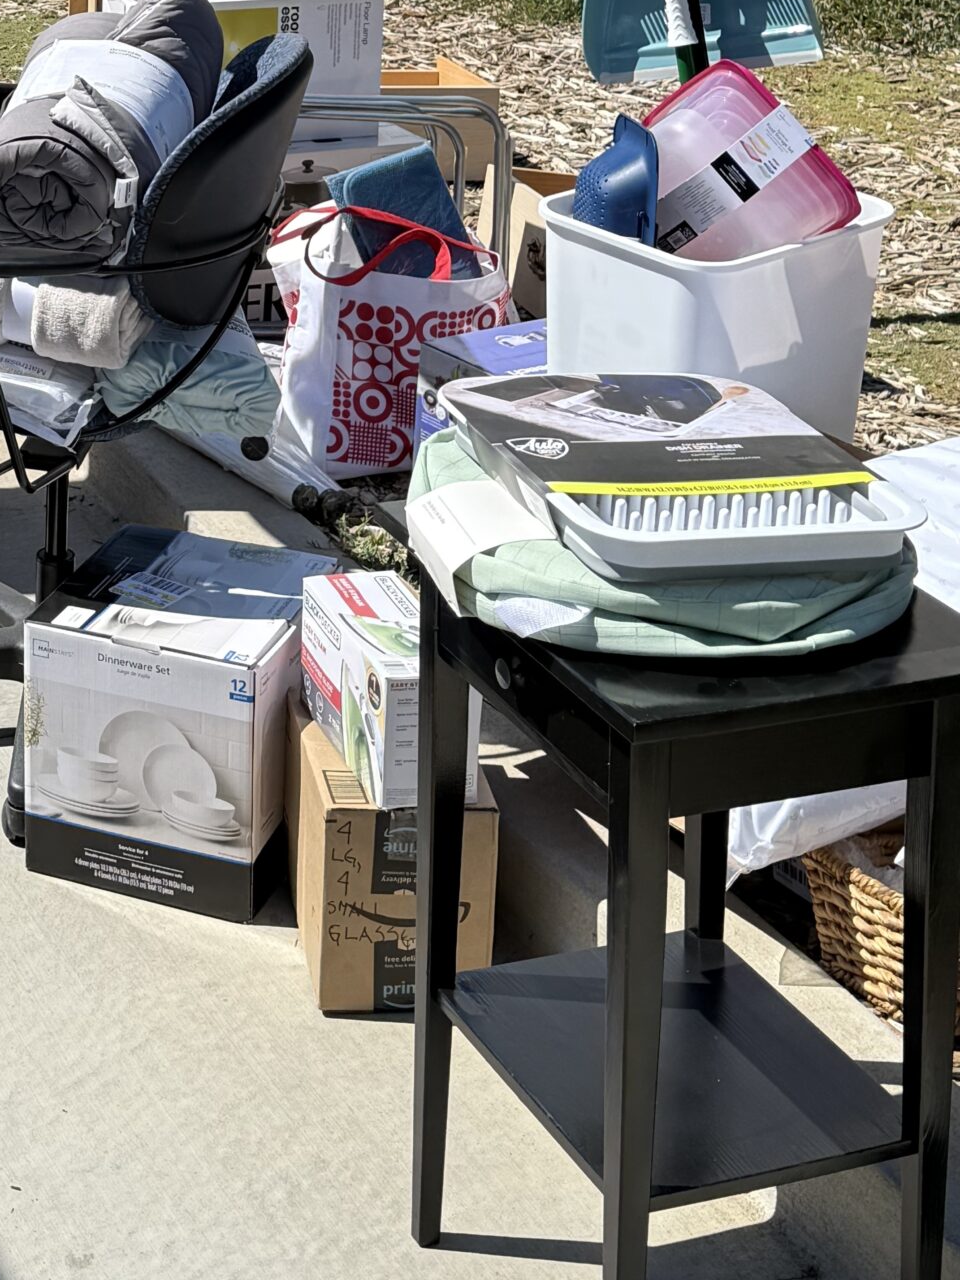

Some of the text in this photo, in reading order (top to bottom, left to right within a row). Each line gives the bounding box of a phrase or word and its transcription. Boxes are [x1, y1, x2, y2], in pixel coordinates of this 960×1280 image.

[280, 6, 290, 33] ess
[290, 6, 300, 33] roo
[361, 1, 371, 45] Floor Lamp
[305, 595, 340, 644] BLACK+DECKER
[97, 652, 170, 675] Dinnerware Set
[231, 679, 247, 693] 12
[337, 821, 351, 844] 4
[337, 871, 349, 896] 4
